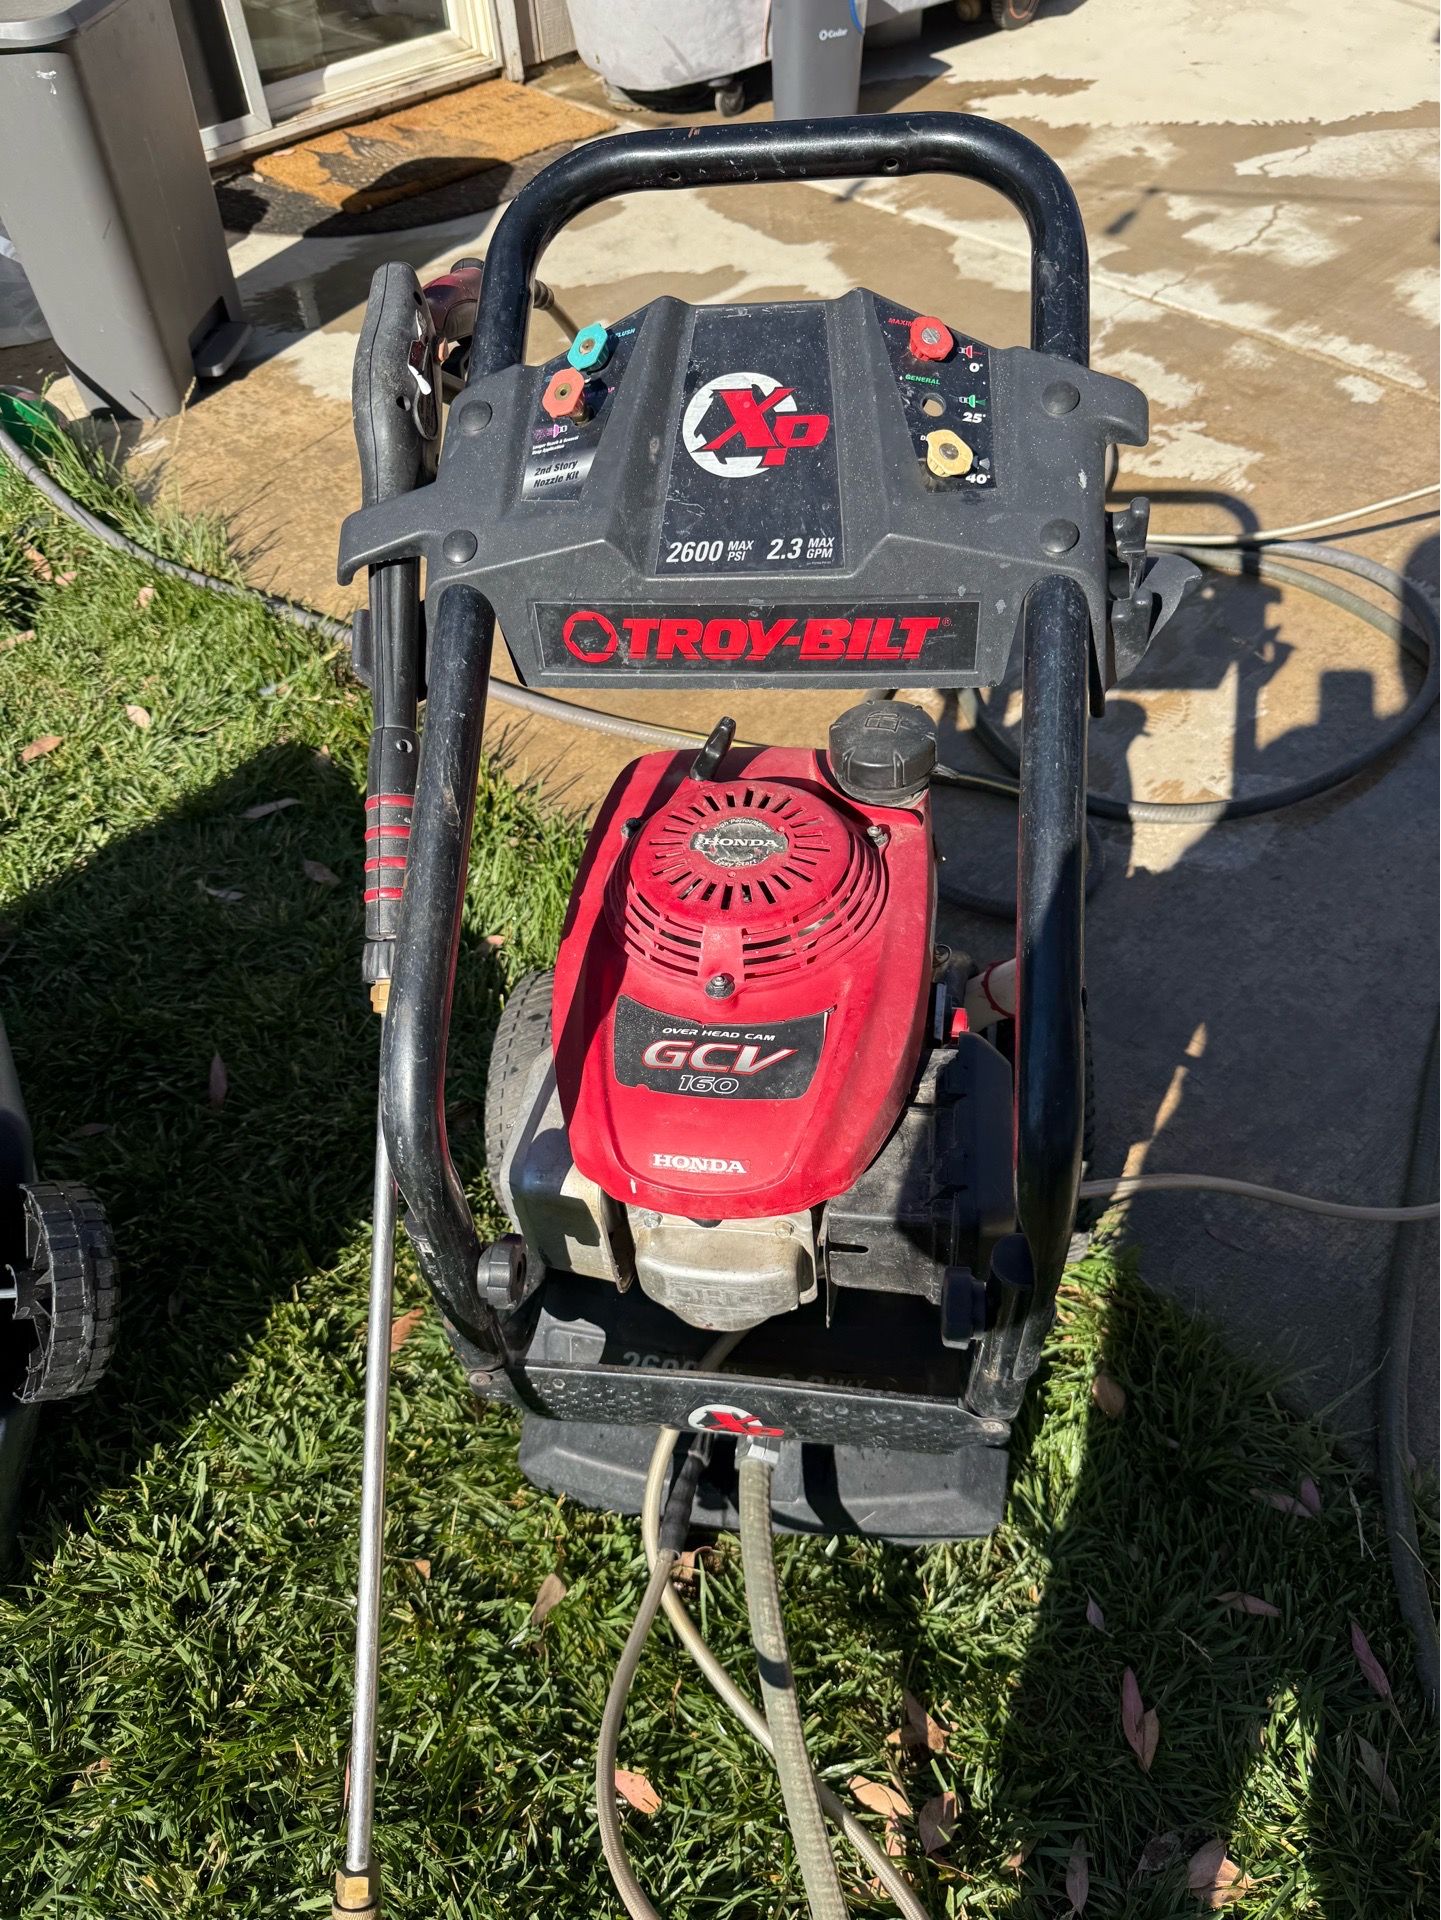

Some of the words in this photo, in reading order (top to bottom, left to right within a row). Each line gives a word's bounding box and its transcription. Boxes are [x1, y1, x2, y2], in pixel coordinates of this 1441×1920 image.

[905, 374, 941, 386] GENERAL
[534, 465, 553, 477] 2nd
[554, 460, 579, 473] Story
[533, 475, 564, 489] Nozzle
[565, 471, 580, 483] Kit
[728, 540, 755, 551] MAX
[767, 538, 804, 560] 2.3
[808, 537, 835, 549] MAX
[666, 541, 724, 563] 2600
[727, 551, 746, 562] PSI
[806, 548, 834, 559] GPM
[702, 837, 780, 849] HONDA
[662, 1026, 698, 1036] OVER
[701, 1030, 740, 1039] HEAD
[744, 1032, 776, 1042] CAM
[642, 1040, 799, 1076] GCV
[678, 1074, 739, 1095] 160
[653, 1153, 747, 1174] HONDA
